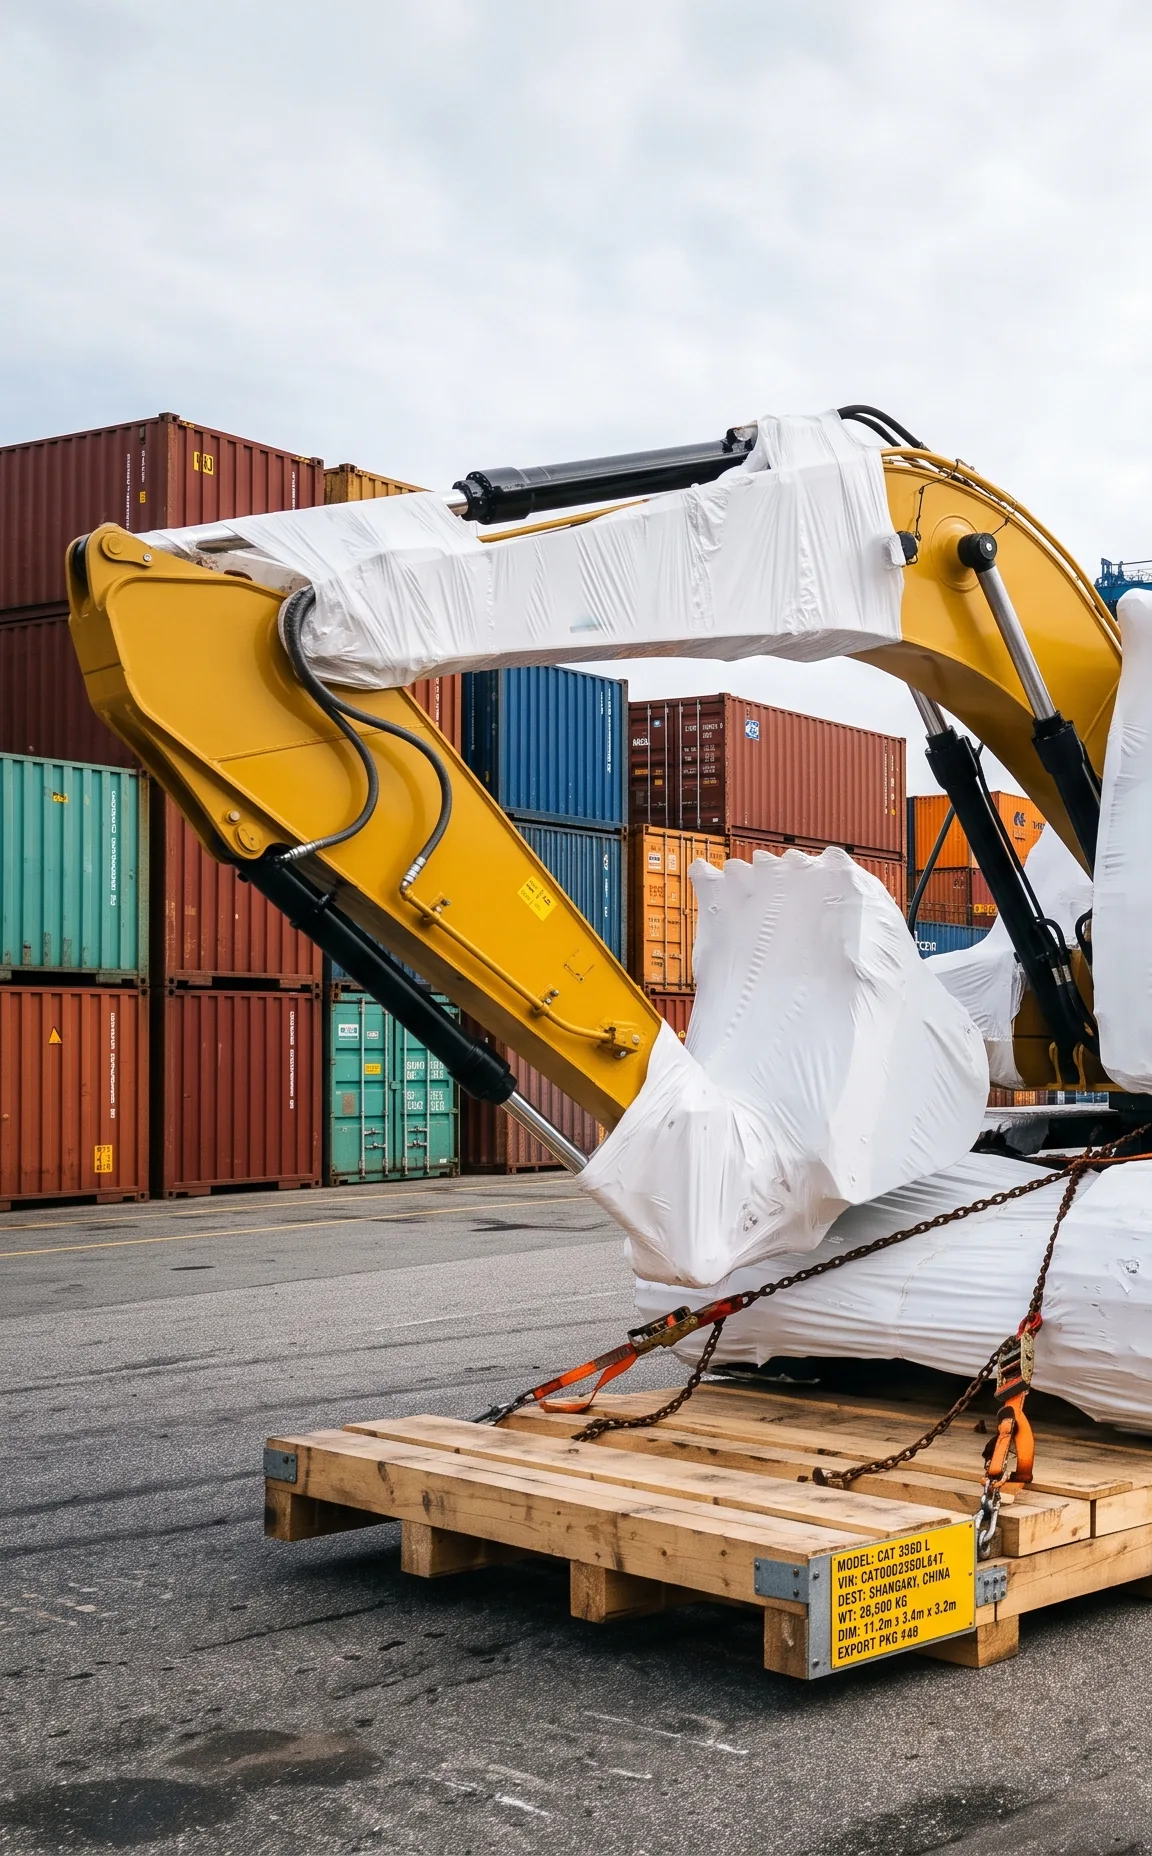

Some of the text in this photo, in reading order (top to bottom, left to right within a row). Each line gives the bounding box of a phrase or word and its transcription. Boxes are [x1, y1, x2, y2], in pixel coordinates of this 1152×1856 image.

[838, 1554, 874, 1572] MODEL:
[878, 1547, 896, 1562] CAT
[925, 1539, 930, 1552] L
[838, 1589, 866, 1606] DEST:
[922, 1567, 950, 1584] CHINA
[838, 1594, 908, 1624] WT: 28,500 KG
[838, 1626, 860, 1642] DIM:
[864, 1618, 892, 1634] 11.2m
[902, 1610, 924, 1624] 3.4m
[926, 1608, 932, 1617] x
[934, 1600, 956, 1614] 3.2m
[838, 1637, 876, 1660] EXPORT
[879, 1632, 898, 1647] PKG
